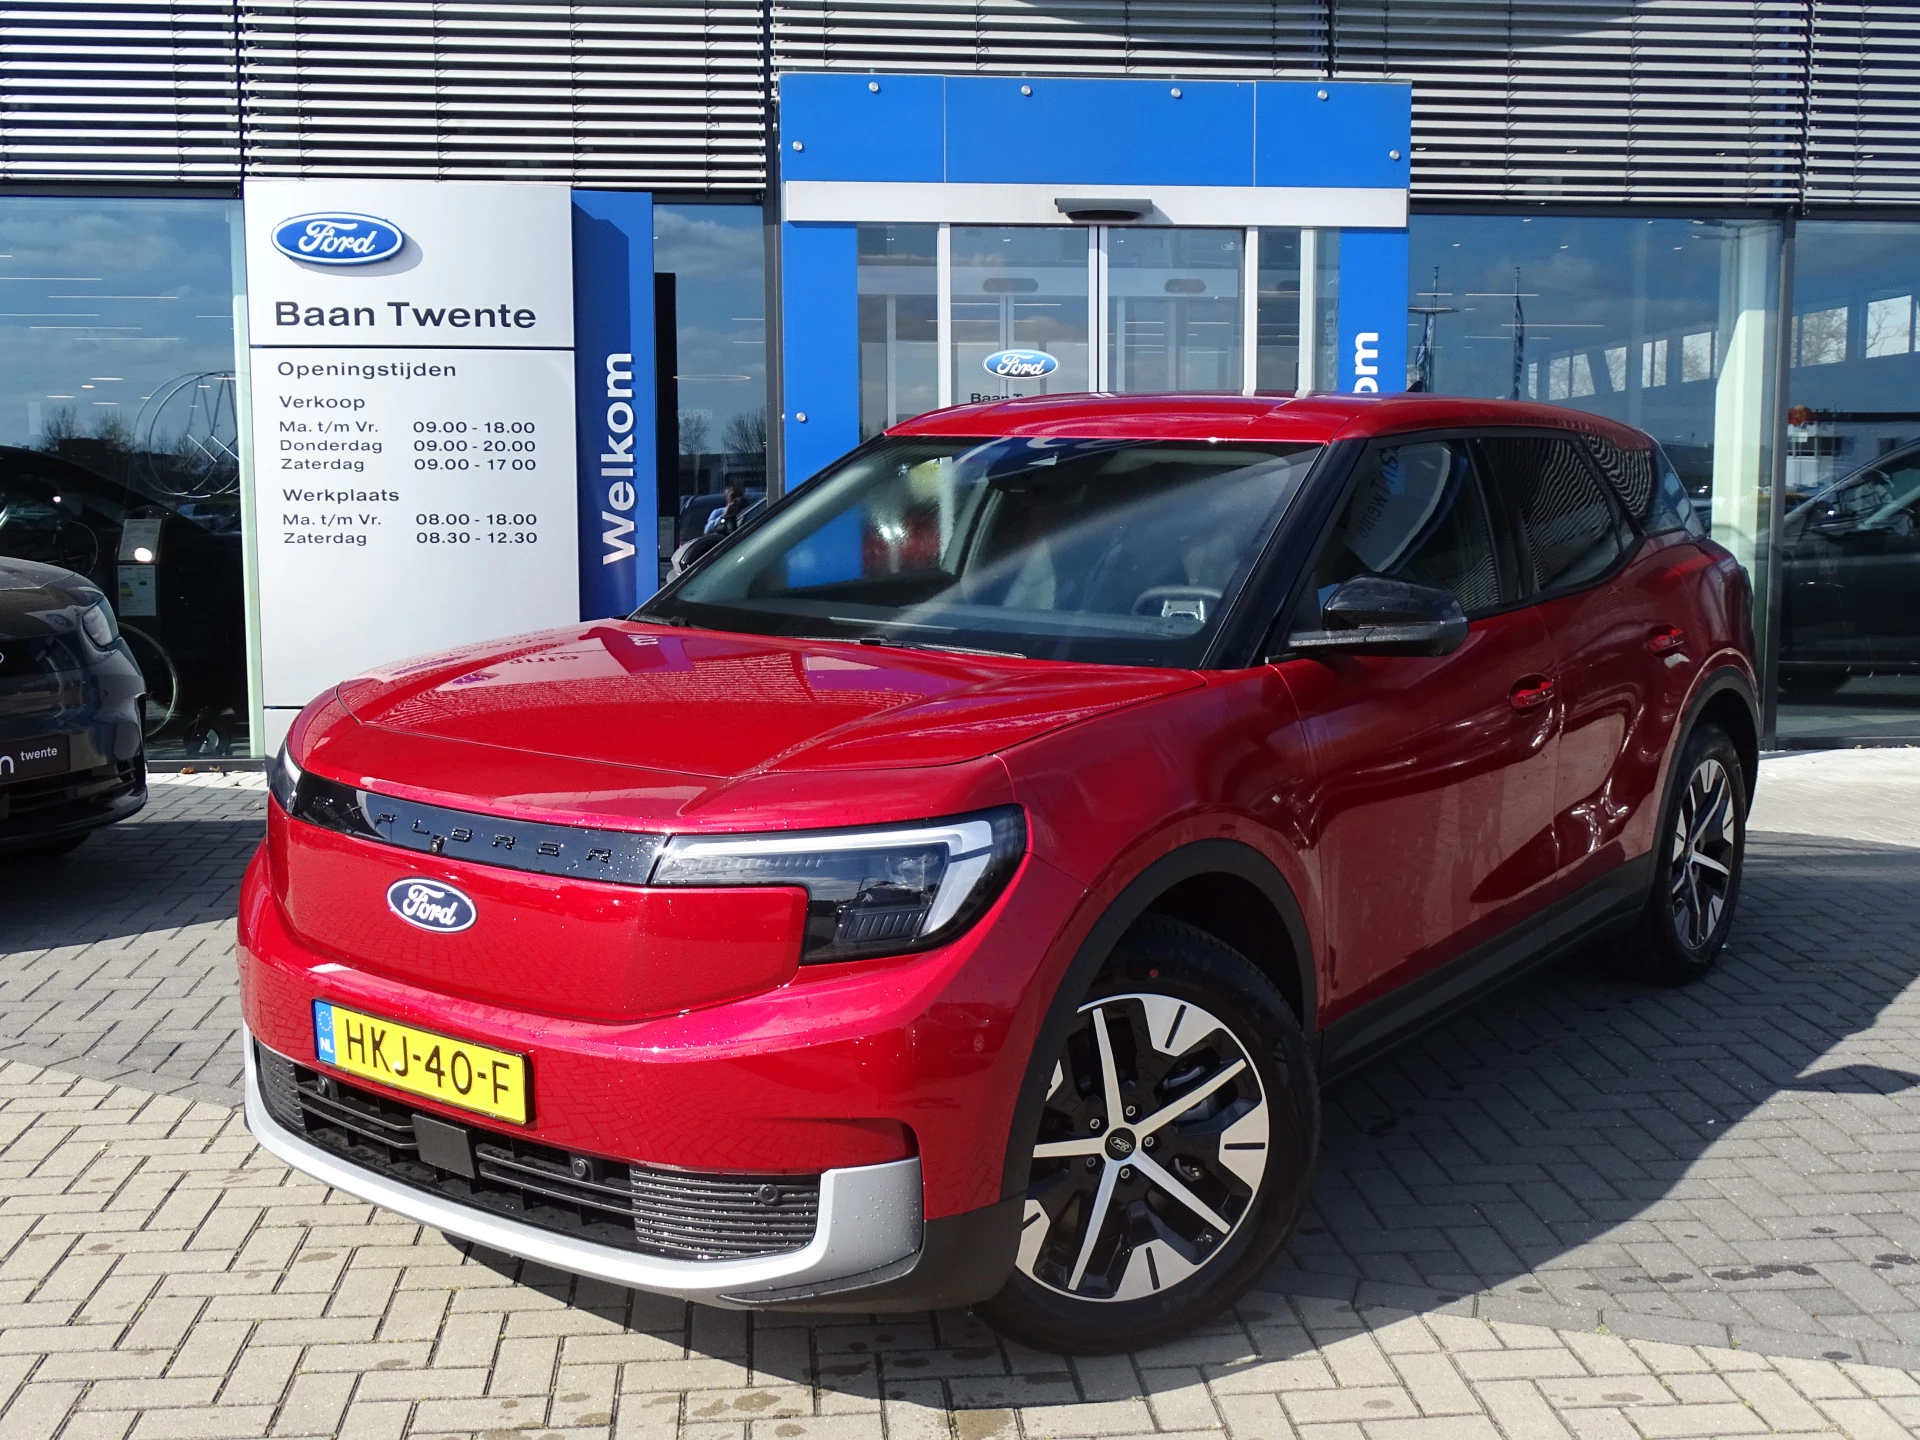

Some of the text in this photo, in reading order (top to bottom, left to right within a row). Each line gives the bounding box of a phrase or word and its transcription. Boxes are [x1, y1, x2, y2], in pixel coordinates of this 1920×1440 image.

[298, 220, 377, 254] Ford
[275, 301, 536, 328] Baan Twente
[277, 361, 456, 380] Openingstijden
[997, 353, 1045, 375] Ford
[279, 395, 365, 411] Verkoop
[279, 421, 312, 432] Ma.
[317, 421, 350, 434] t/m
[355, 421, 379, 432] Vr.
[413, 421, 467, 433] 09.00
[484, 422, 535, 433] 18.00
[280, 440, 382, 454] Donderdag
[414, 440, 468, 452] 09.00
[483, 440, 536, 452] 20.00
[281, 458, 364, 473] Zaterdag
[414, 459, 469, 470] 09.00
[600, 353, 635, 565] Welkom
[282, 489, 400, 504] Werkplaats
[283, 514, 315, 525] Ma.
[320, 514, 353, 527] t/m
[358, 514, 381, 525] Vr.
[416, 513, 470, 525] 08.00
[487, 514, 537, 525] 18.00
[284, 533, 367, 546] Zaterdag
[416, 532, 470, 544] 08.30
[488, 532, 538, 544] 12.30
[20, 746, 58, 761] twente
[312, 796, 613, 864] XPLORER
[402, 884, 458, 926] Ford
[320, 1037, 334, 1054] NL
[345, 1018, 510, 1104] HKJ-40-F
